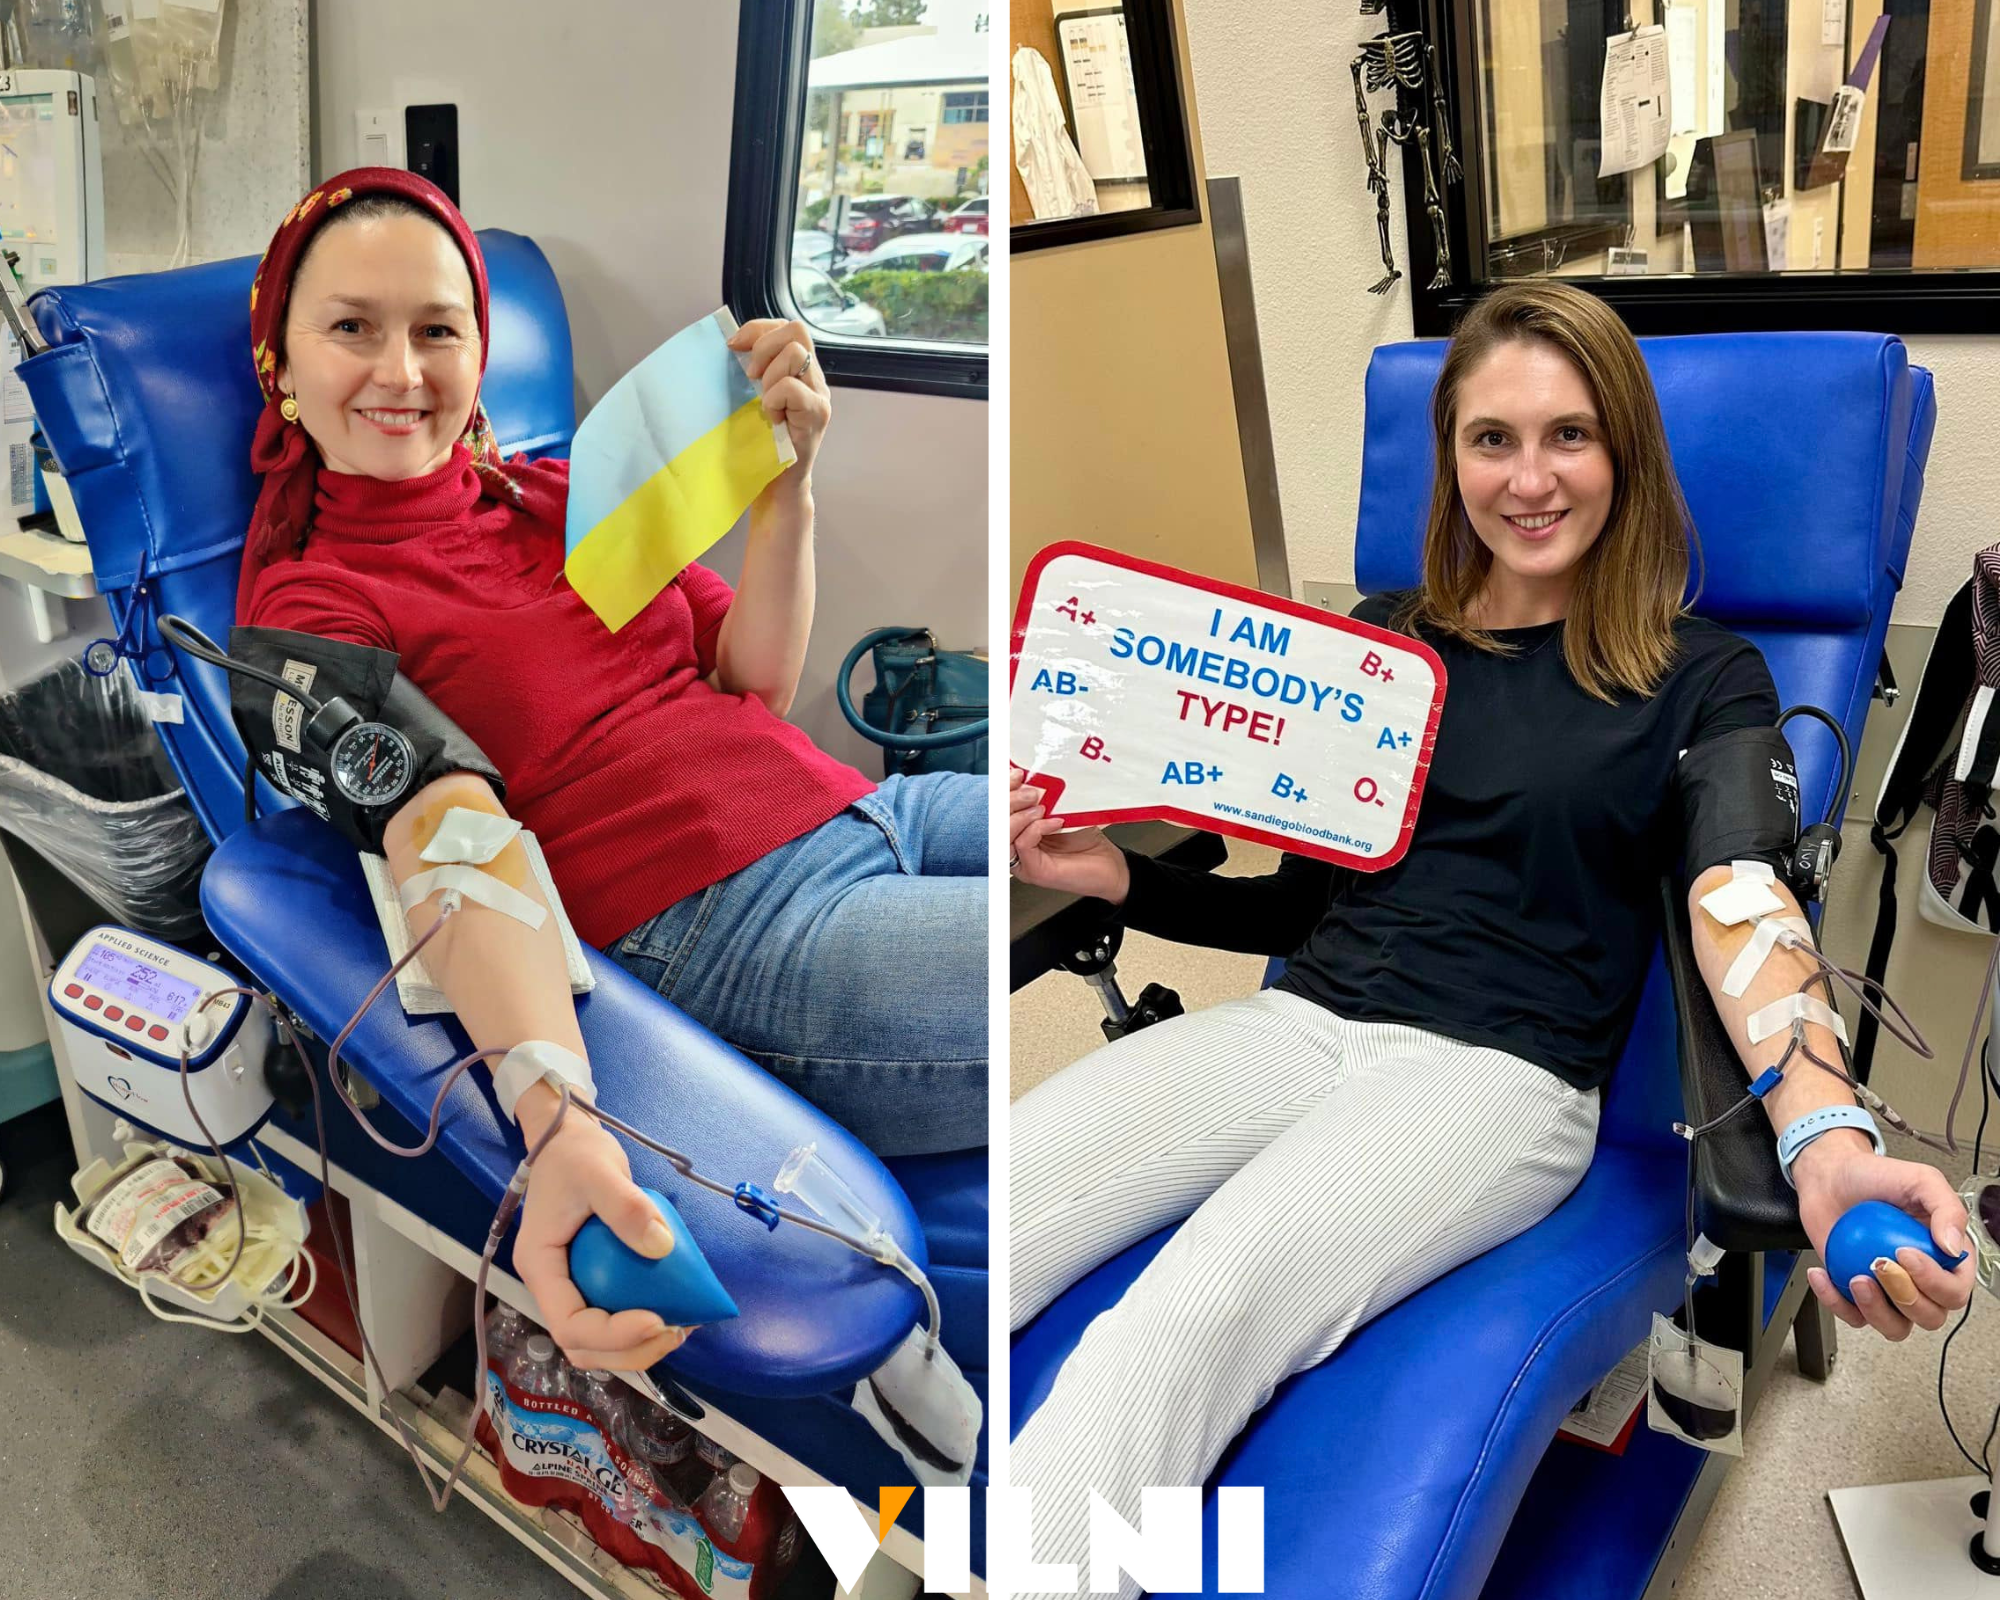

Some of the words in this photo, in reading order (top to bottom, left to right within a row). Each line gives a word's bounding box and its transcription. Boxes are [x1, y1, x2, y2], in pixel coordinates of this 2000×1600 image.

[1056, 596, 1096, 626] A+
[1210, 608, 1222, 637] I
[1229, 617, 1292, 656] AM
[1031, 669, 1089, 695] AB-
[1110, 627, 1365, 722] SOMEBODY'S
[1360, 651, 1395, 684] B+
[1176, 690, 1285, 746] TYPE!
[1080, 736, 1112, 764] B-
[1377, 727, 1412, 751] A+
[1161, 761, 1223, 785] AB+
[1271, 773, 1308, 803] B+
[1353, 777, 1385, 809] O-
[1213, 800, 1373, 852] www.sandiegobloodbank.org
[98, 932, 133, 951] APPLIED
[134, 947, 171, 967] SCIENCE
[130, 964, 158, 984] 252
[523, 1397, 579, 1415] BOTTLED
[532, 1462, 573, 1474] ALPINE
